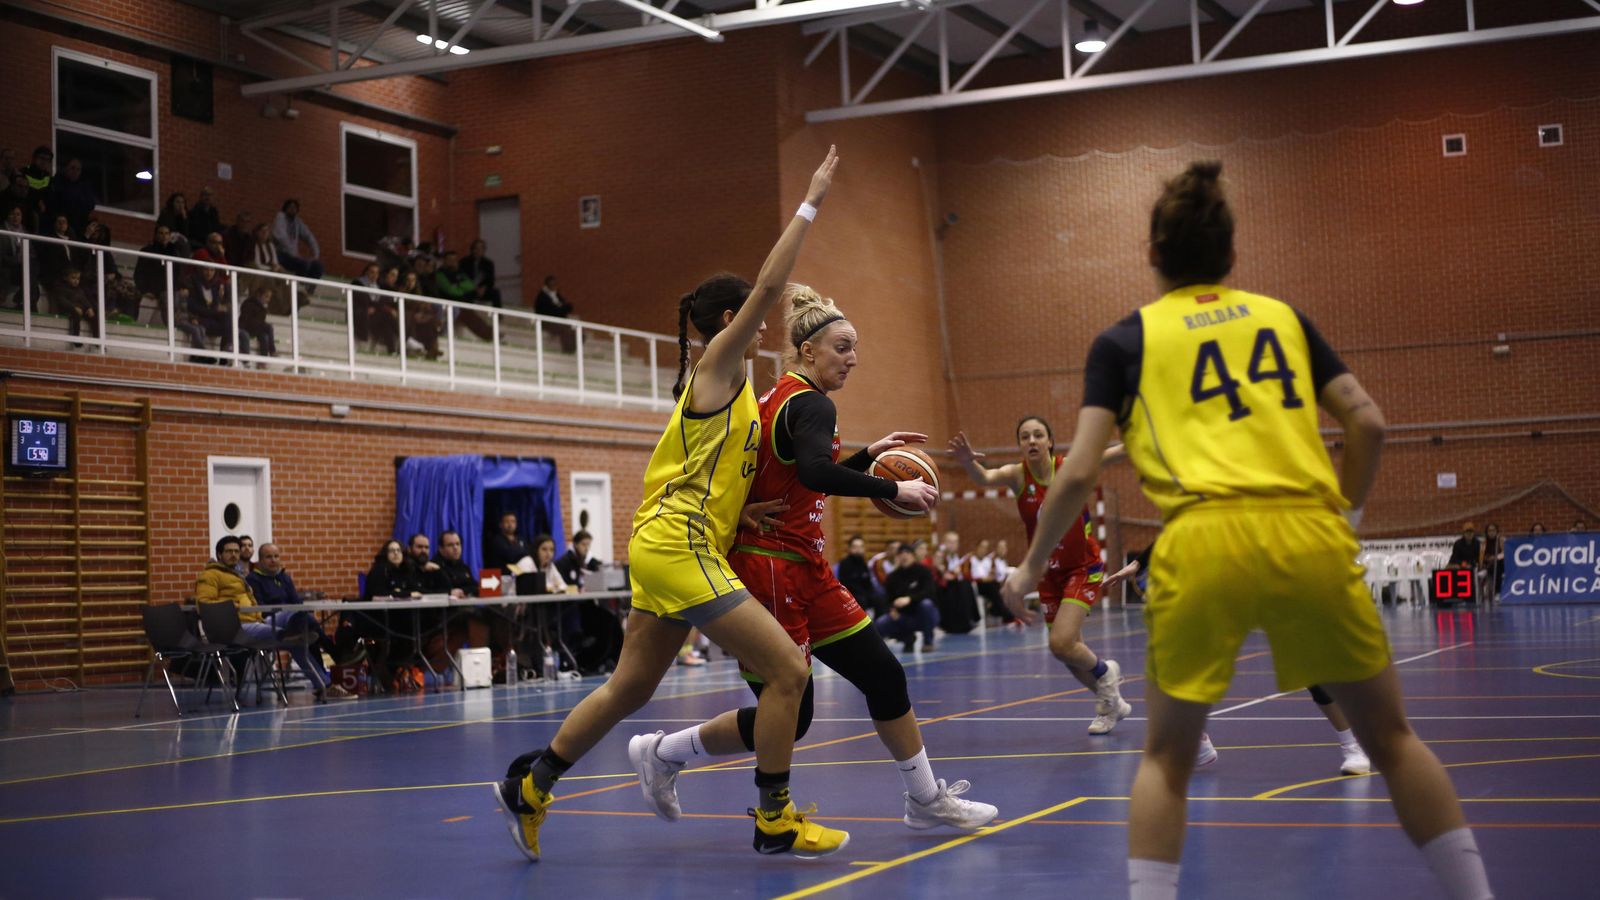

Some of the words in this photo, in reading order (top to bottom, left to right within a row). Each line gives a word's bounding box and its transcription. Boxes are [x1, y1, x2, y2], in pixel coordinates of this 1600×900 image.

[1190, 327, 1304, 421] 44
[1514, 540, 1595, 567] Corral
[1435, 570, 1471, 598] 03
